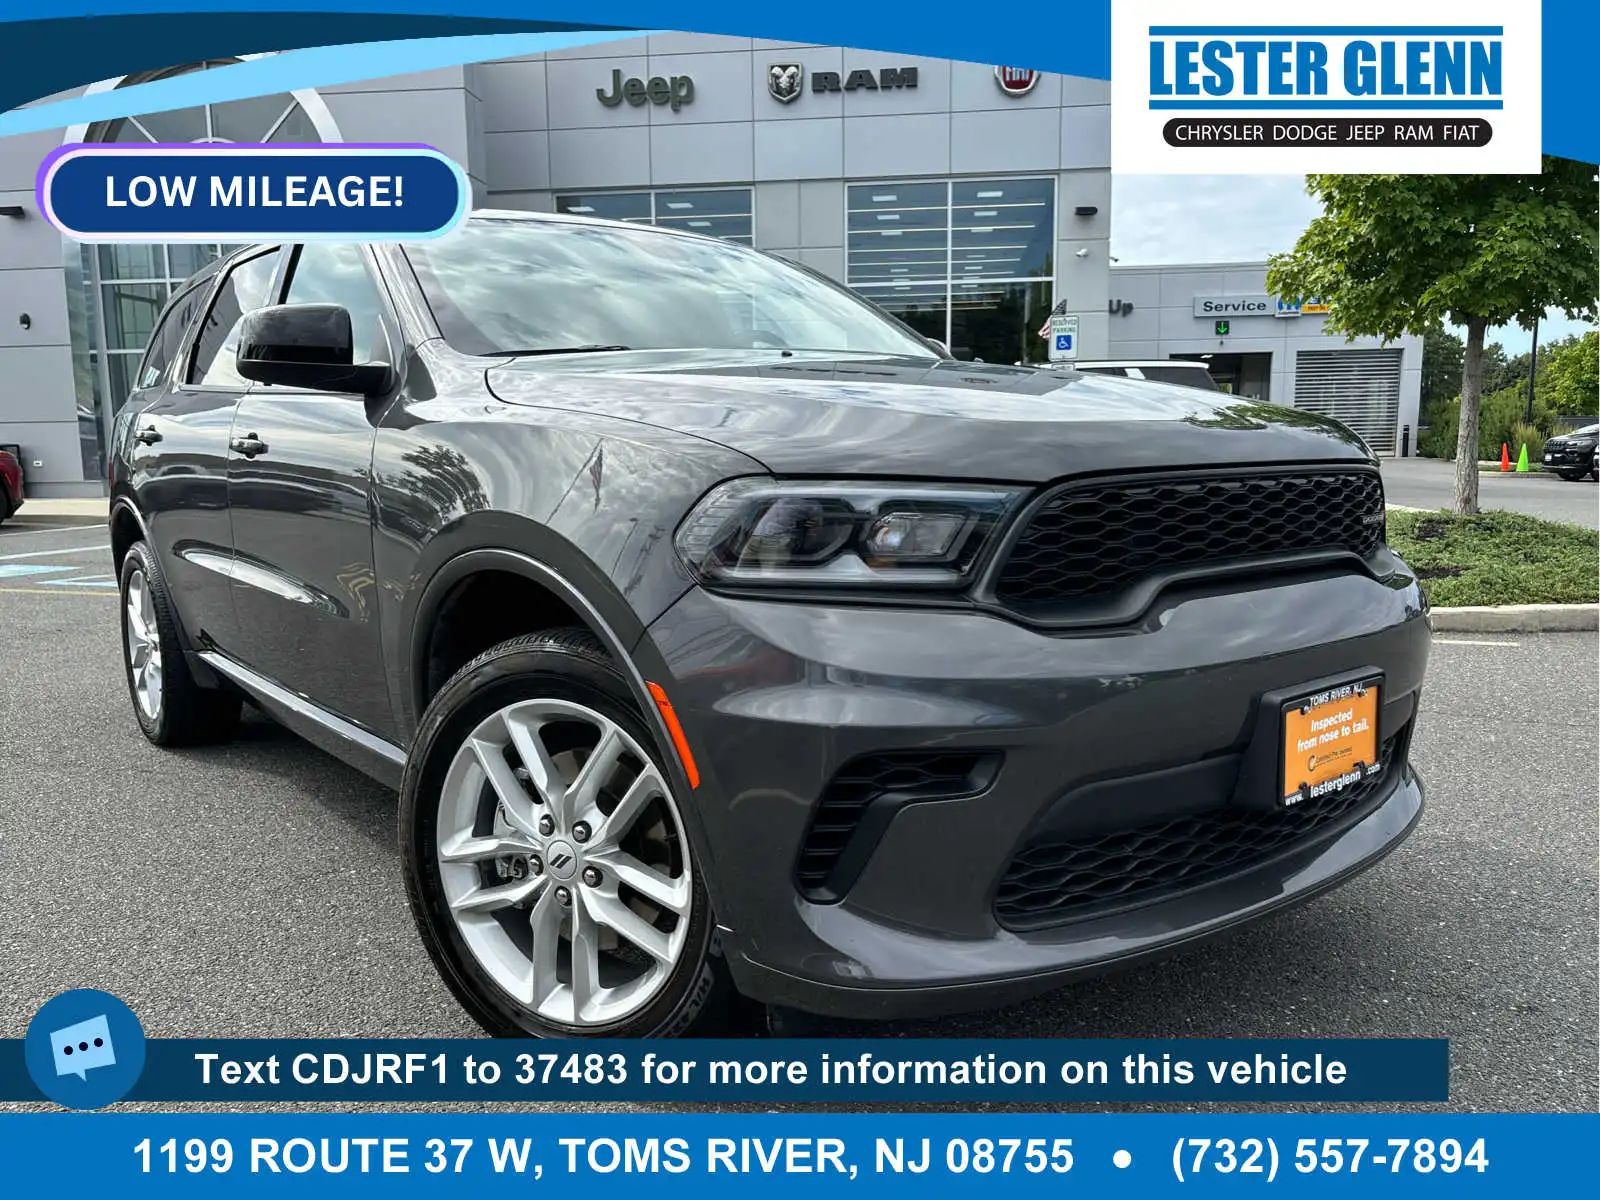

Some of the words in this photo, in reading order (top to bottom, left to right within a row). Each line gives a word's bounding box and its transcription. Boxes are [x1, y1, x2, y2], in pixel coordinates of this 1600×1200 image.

[596, 69, 694, 112] Jeep
[812, 67, 918, 92] RAM
[1203, 300, 1266, 312] Service
[1309, 693, 1329, 706] TOMS
[1311, 707, 1353, 733] Inspected
[1297, 736, 1317, 754] from
[1319, 729, 1339, 744] nose
[1341, 724, 1351, 736] to
[1310, 770, 1361, 798] lesterglenn
